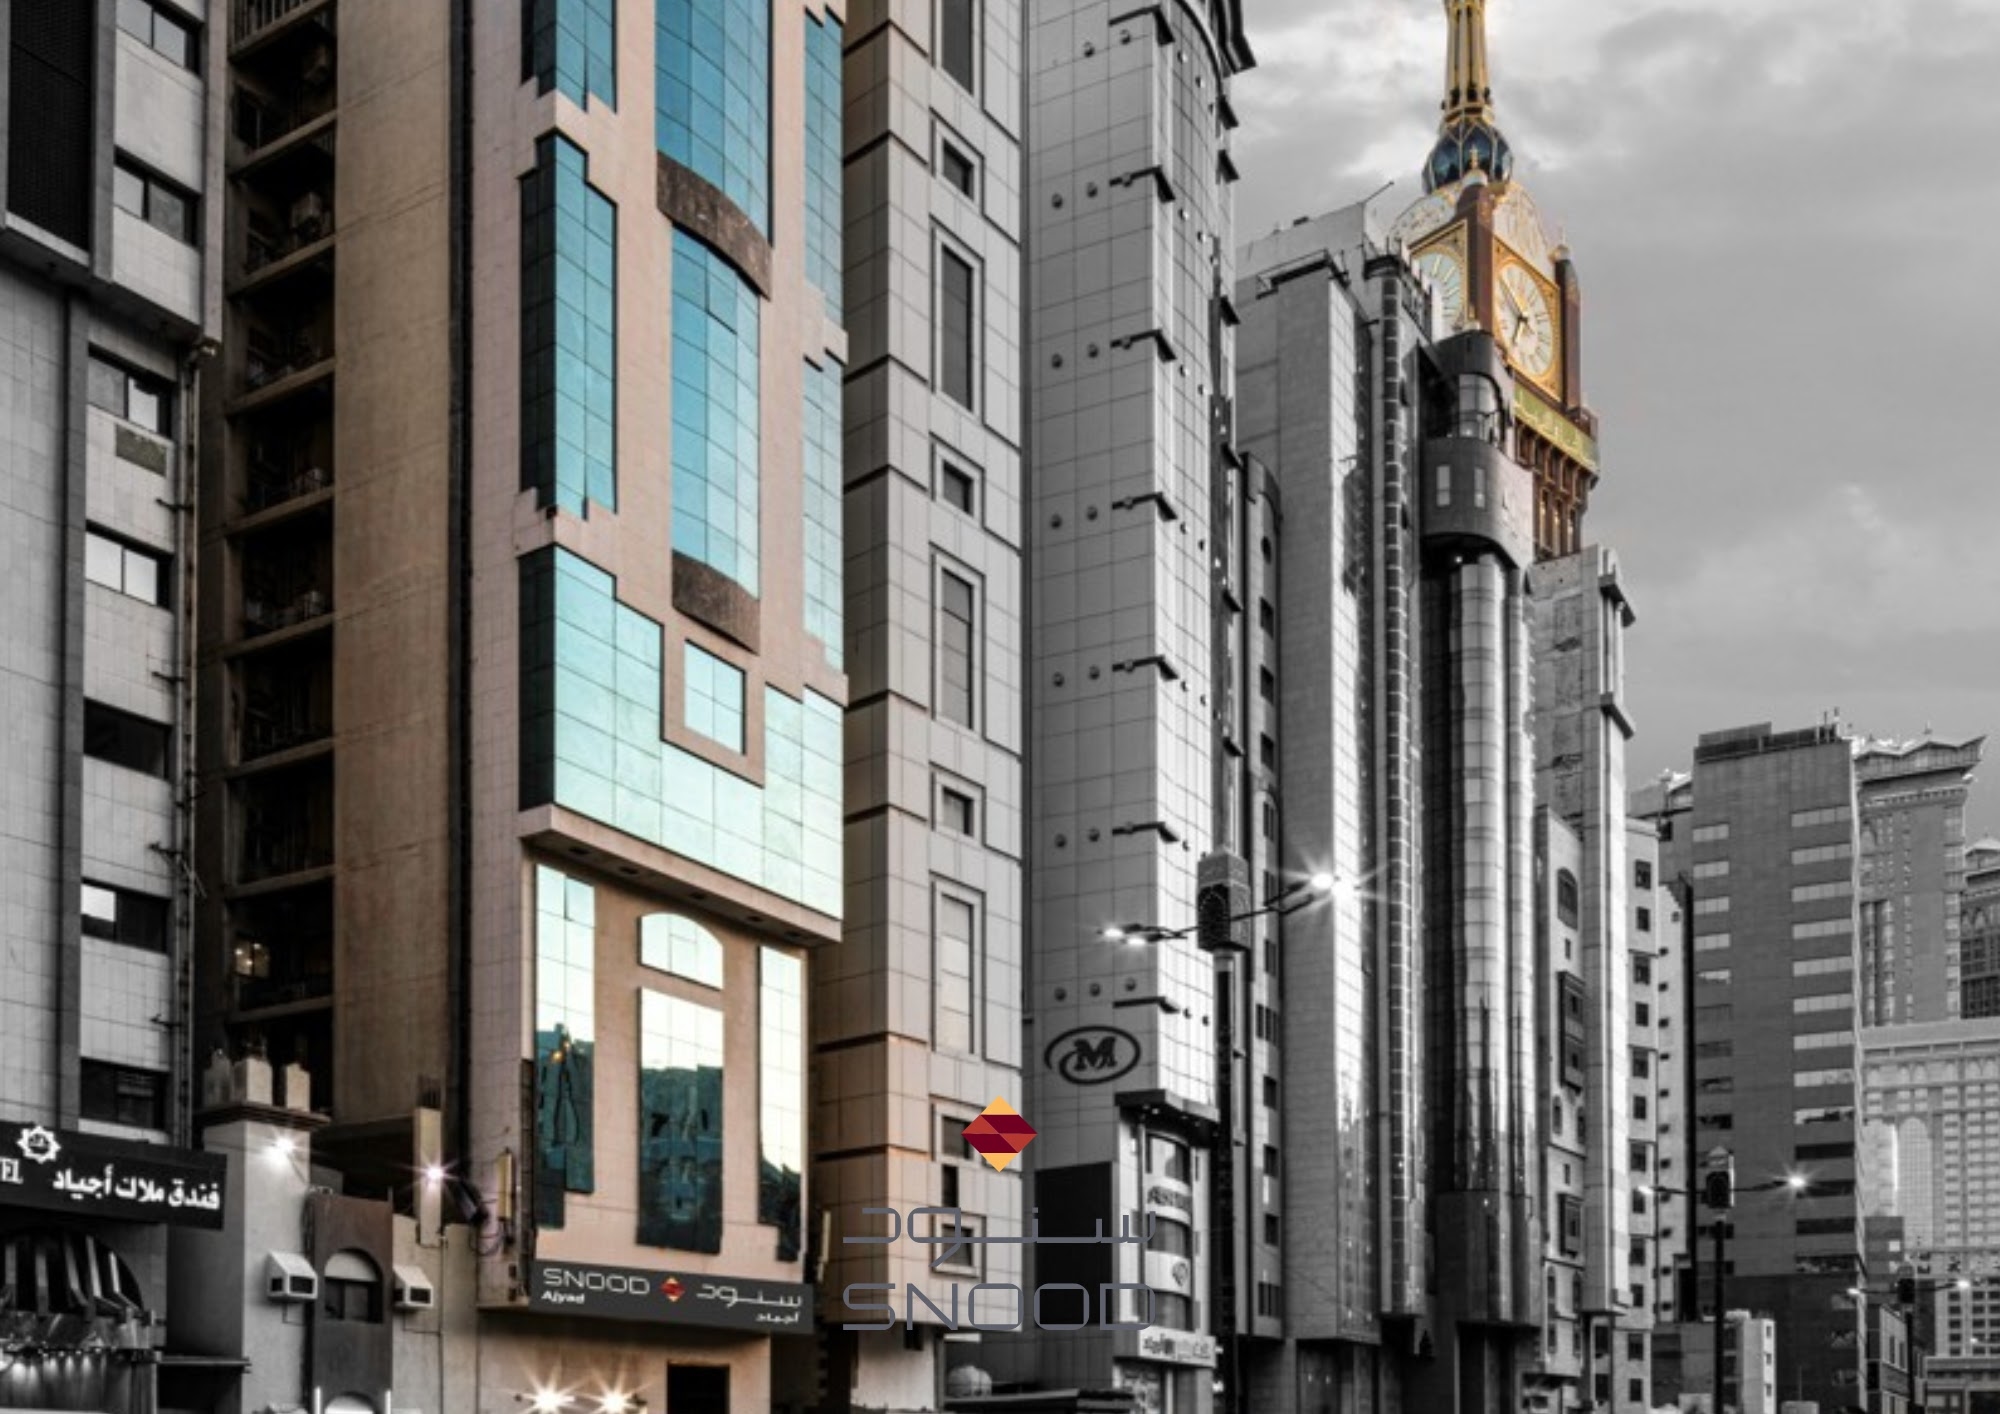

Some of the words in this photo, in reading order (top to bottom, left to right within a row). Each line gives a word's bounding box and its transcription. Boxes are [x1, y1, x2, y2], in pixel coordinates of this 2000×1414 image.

[53, 1163, 114, 1200] أجياد
[114, 1176, 165, 1202] ملاك
[167, 1178, 221, 1210] فندق
[543, 1267, 651, 1295] SNOOD
[541, 1289, 585, 1305] Ajyad
